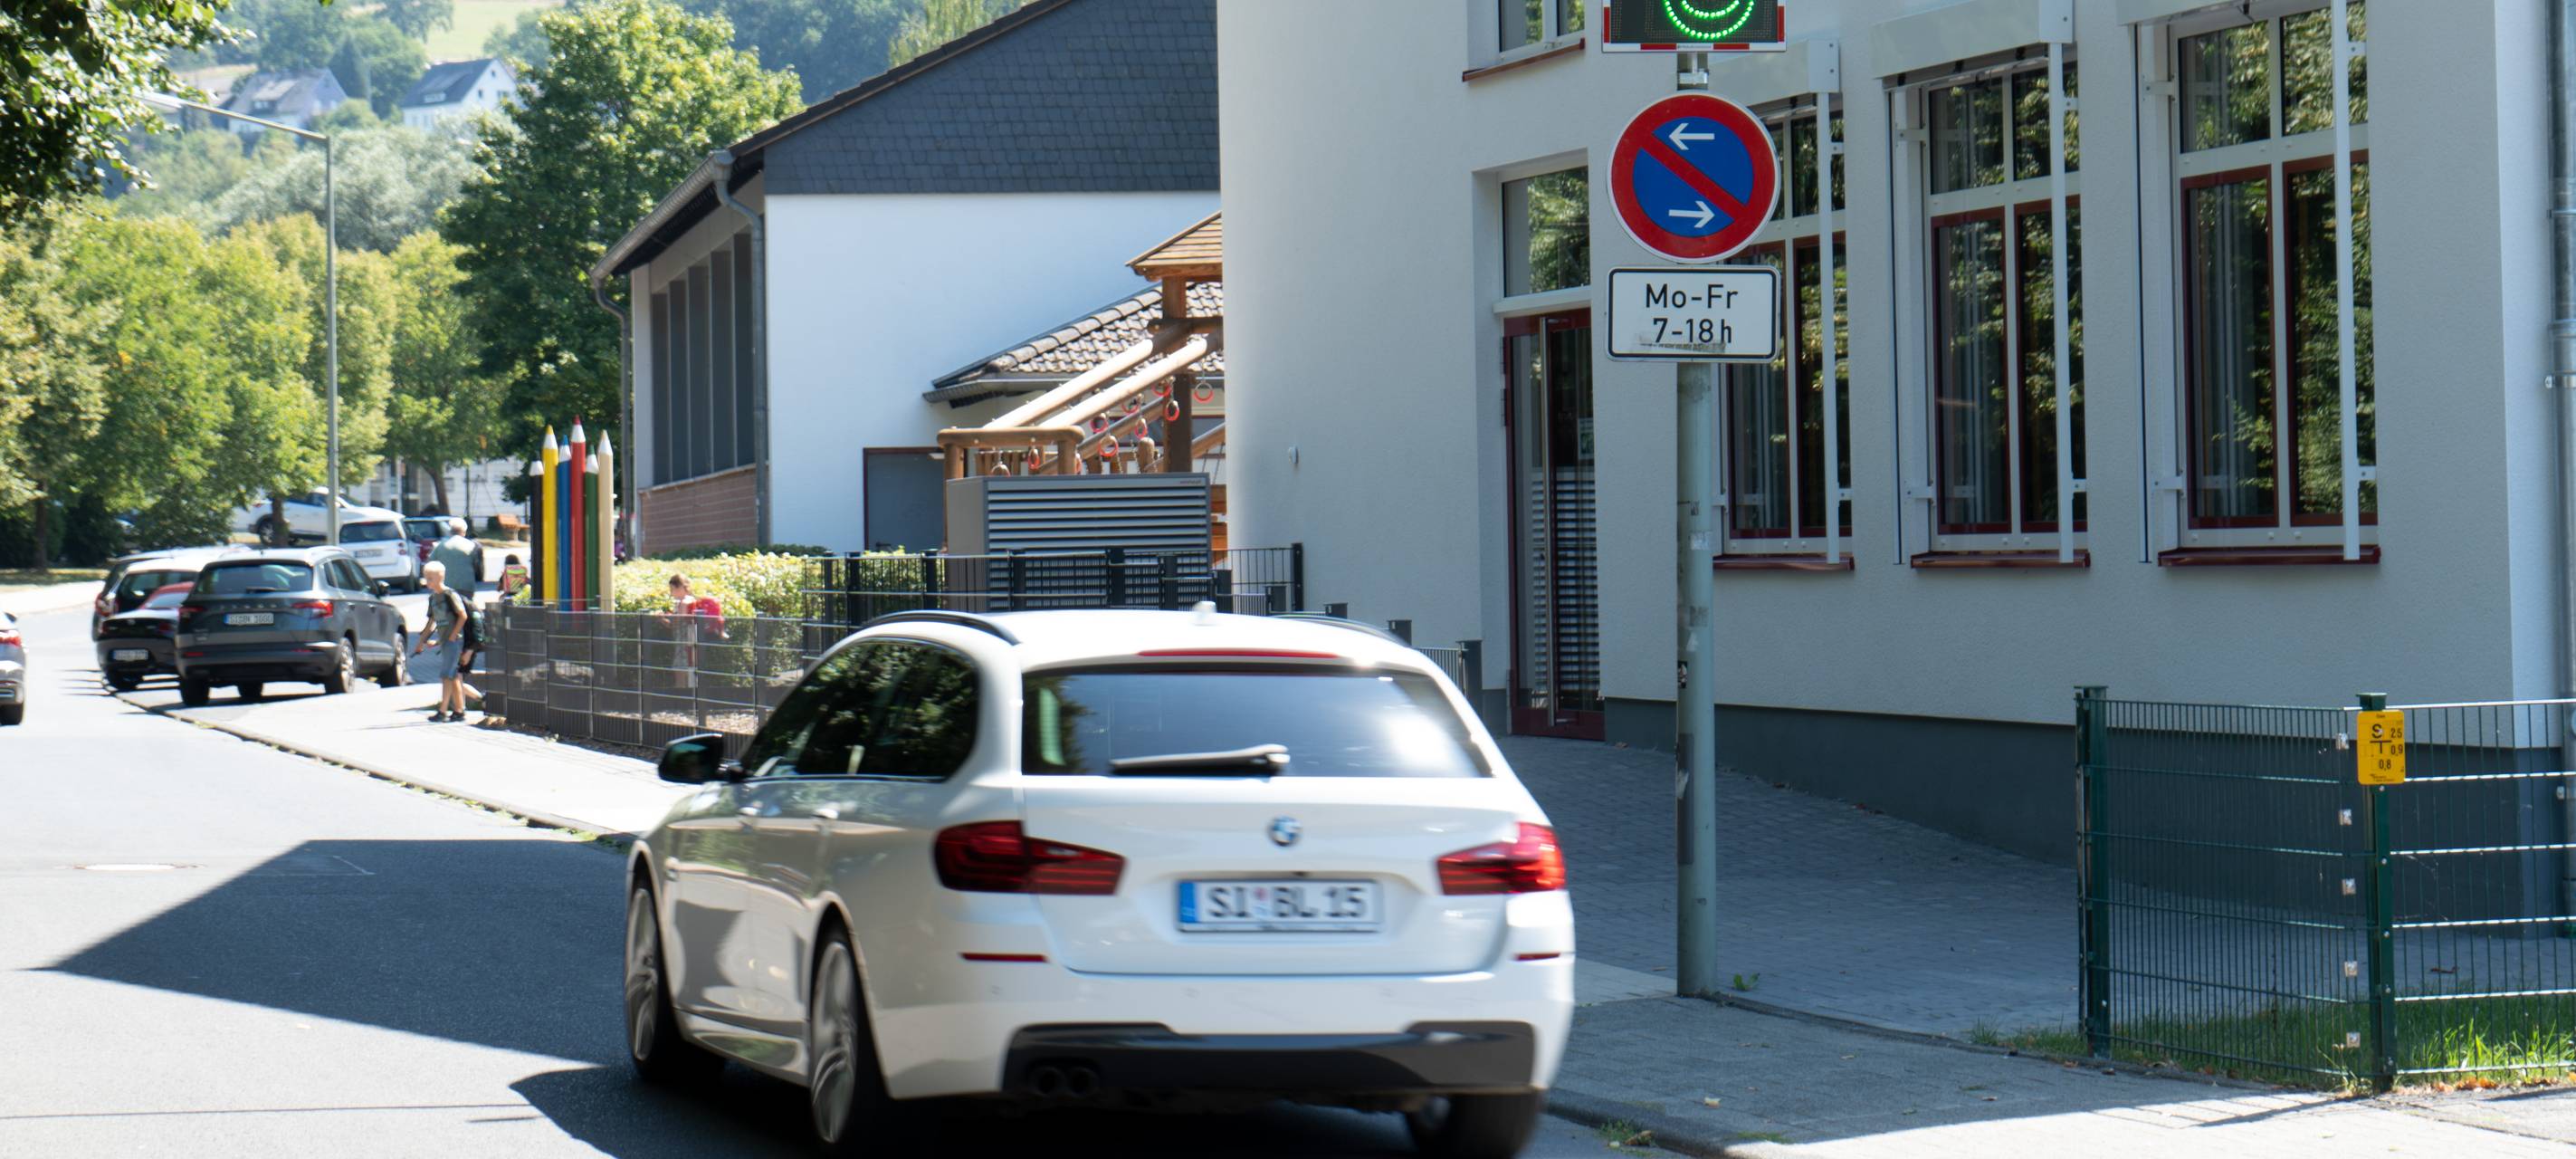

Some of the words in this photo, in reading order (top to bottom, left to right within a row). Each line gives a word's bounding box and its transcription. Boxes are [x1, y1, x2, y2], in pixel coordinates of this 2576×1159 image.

[1646, 283, 1739, 309] Mo-Fr
[1208, 886, 1246, 917] SI
[1274, 886, 1317, 917] BL
[1325, 886, 1366, 917] 15
